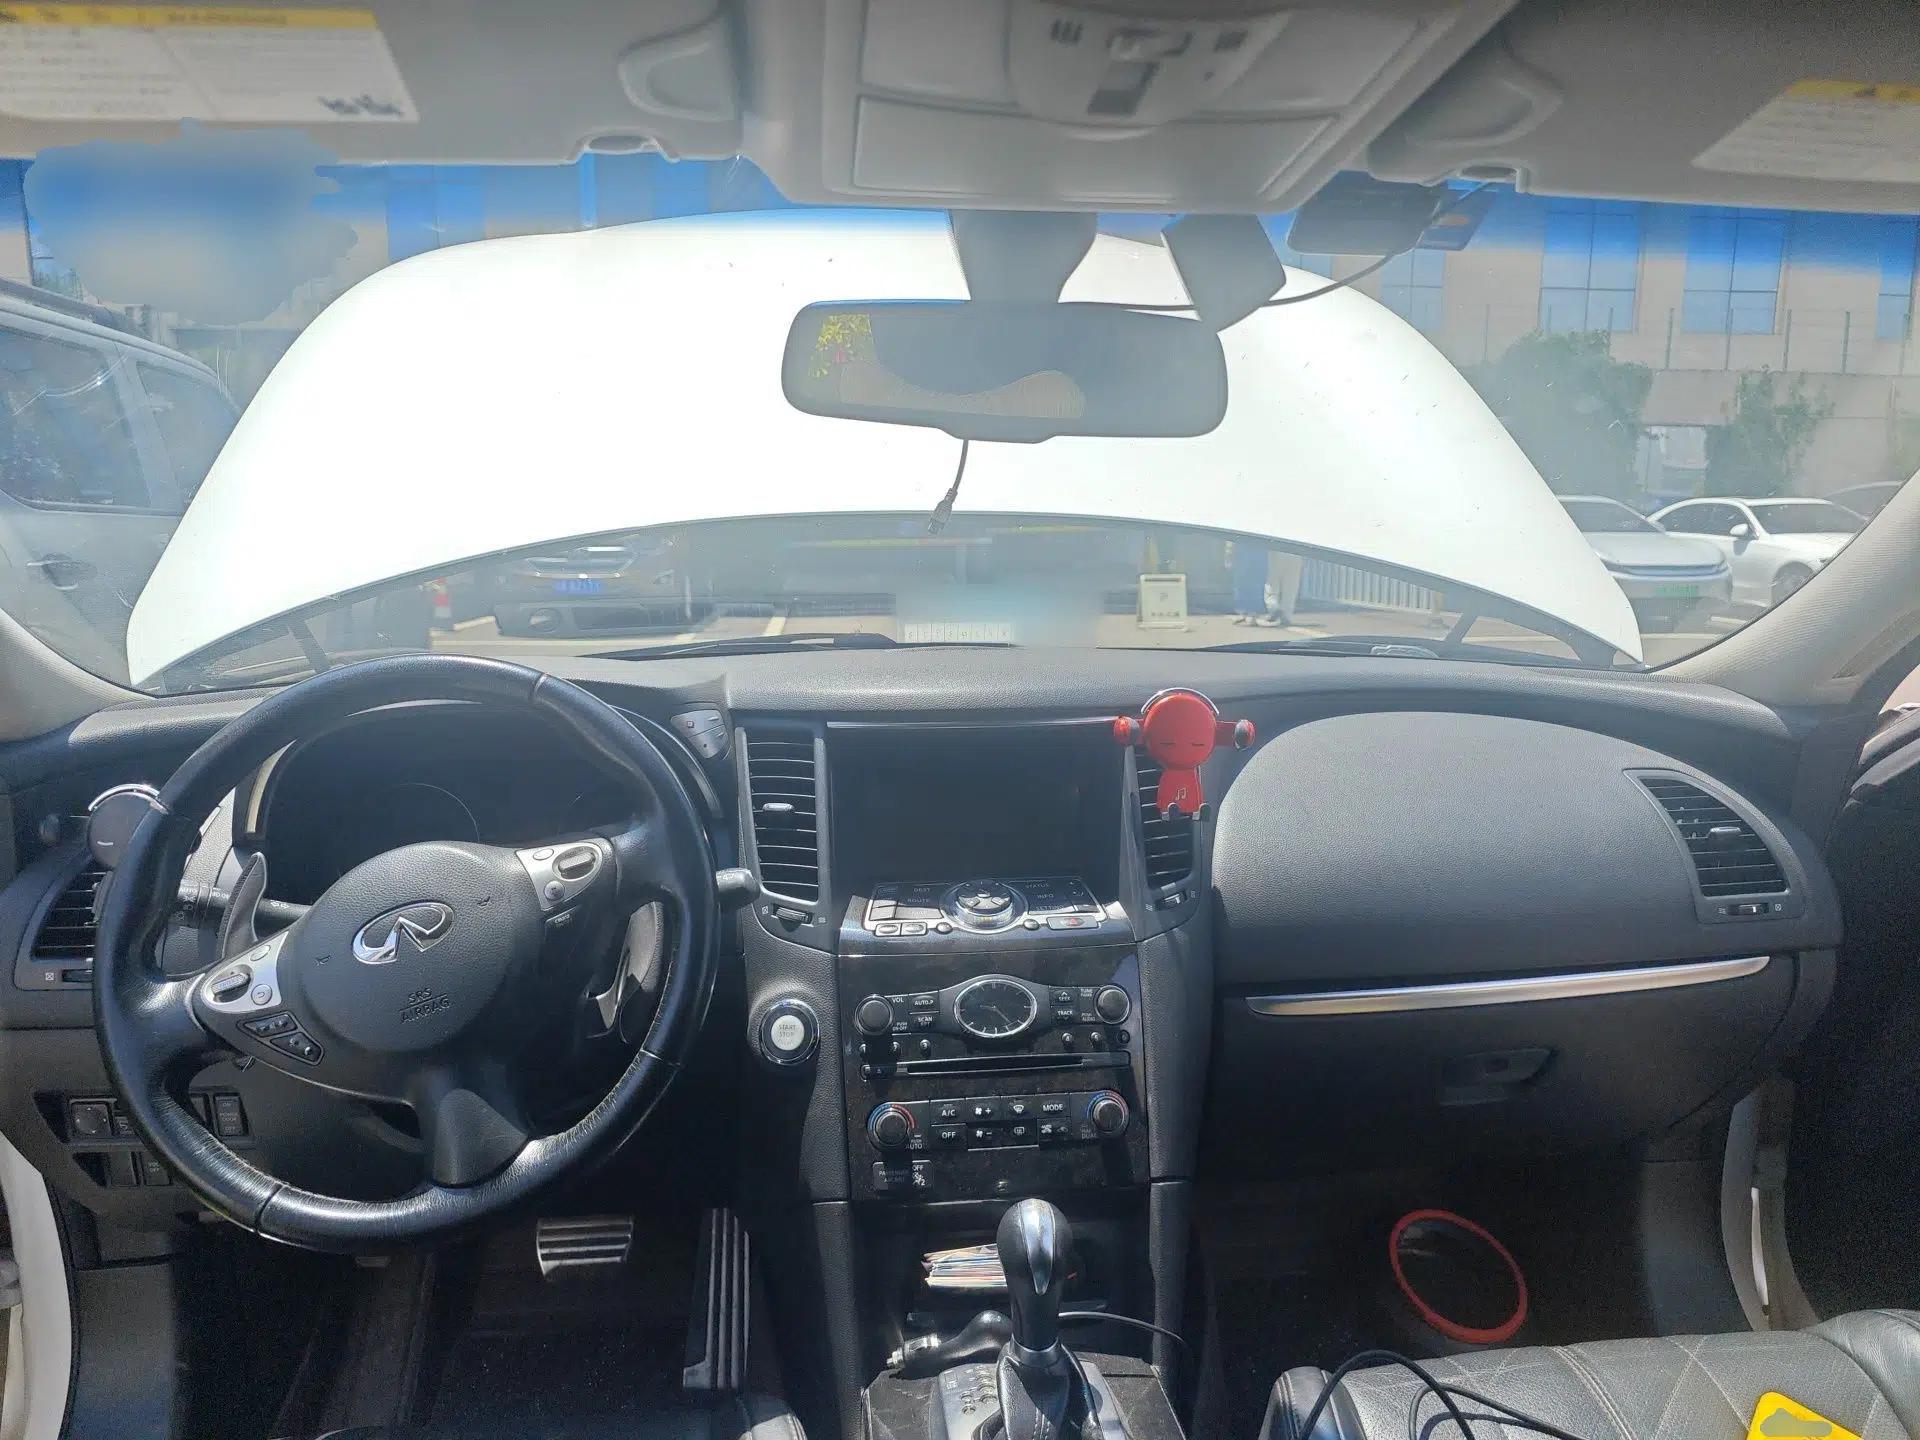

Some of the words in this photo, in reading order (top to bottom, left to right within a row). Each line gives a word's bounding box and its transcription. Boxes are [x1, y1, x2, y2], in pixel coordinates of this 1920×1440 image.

[408, 988, 432, 1005] SRS
[401, 998, 450, 1023] AIRBAG
[1042, 1103, 1064, 1112] MODE
[941, 1109, 956, 1117] A/C
[941, 1131, 956, 1139] OFF
